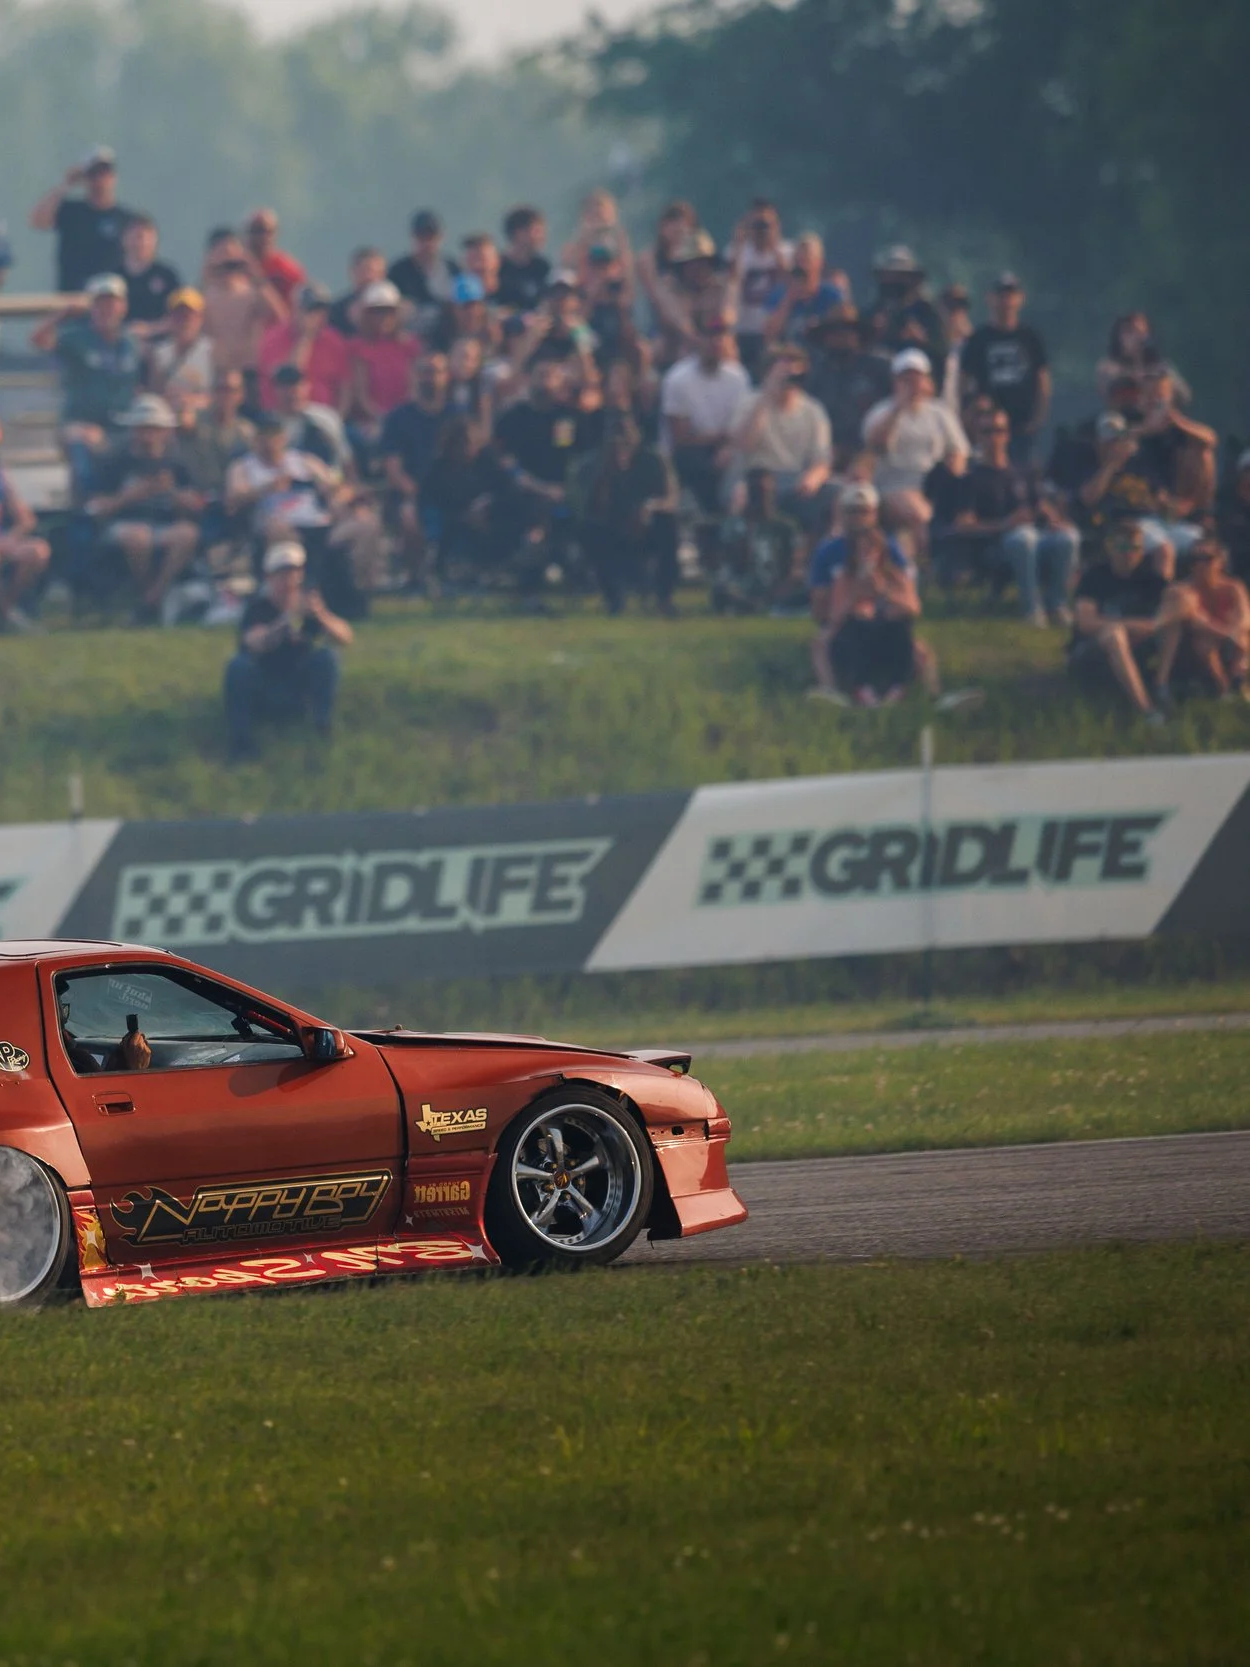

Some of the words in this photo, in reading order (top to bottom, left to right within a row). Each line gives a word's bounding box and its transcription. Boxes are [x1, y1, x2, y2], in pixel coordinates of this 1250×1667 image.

[810, 815, 1166, 895] GRIDLIFE
[233, 850, 600, 931] GRIDLIFE
[431, 1108, 487, 1126] TEXAS
[183, 1215, 342, 1242] AUTOMOTIVE
